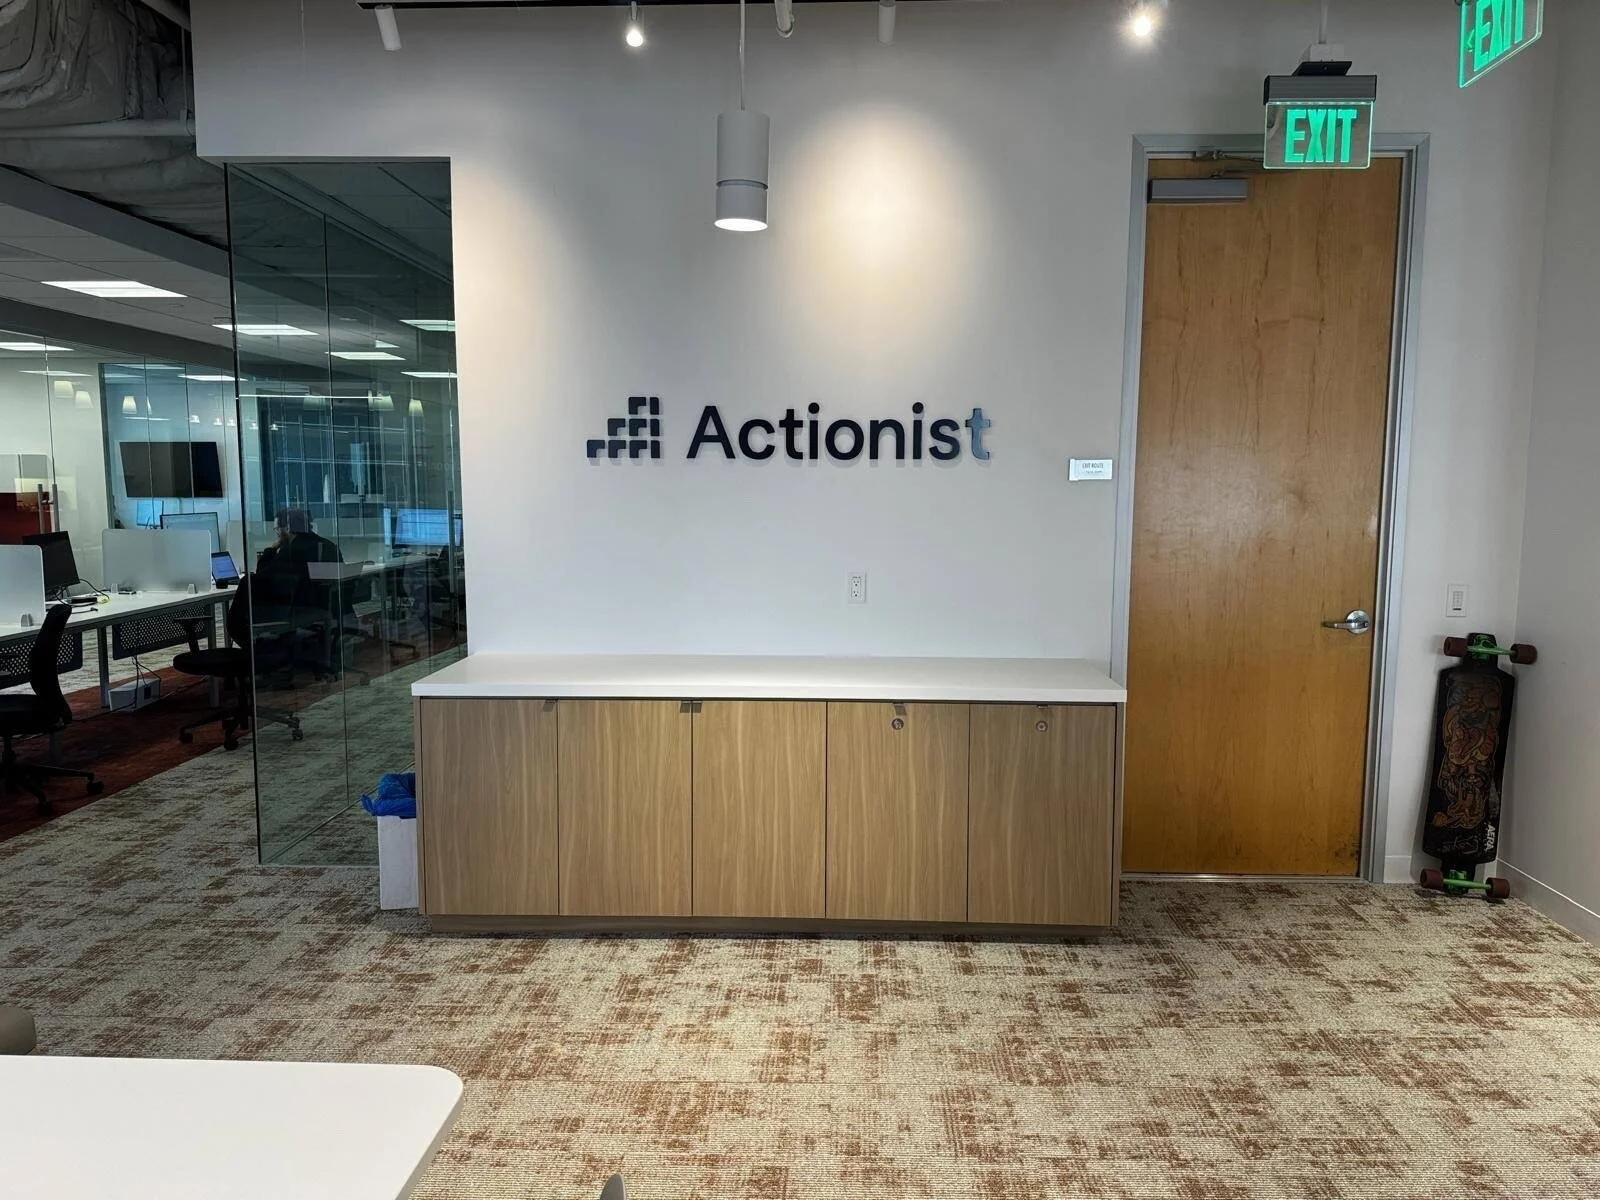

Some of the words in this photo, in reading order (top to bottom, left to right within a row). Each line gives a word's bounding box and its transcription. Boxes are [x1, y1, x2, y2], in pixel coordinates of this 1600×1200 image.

[1284, 109, 1357, 163] EXIT
[686, 402, 990, 460] Actionist
[1485, 824, 1496, 851] AERA
